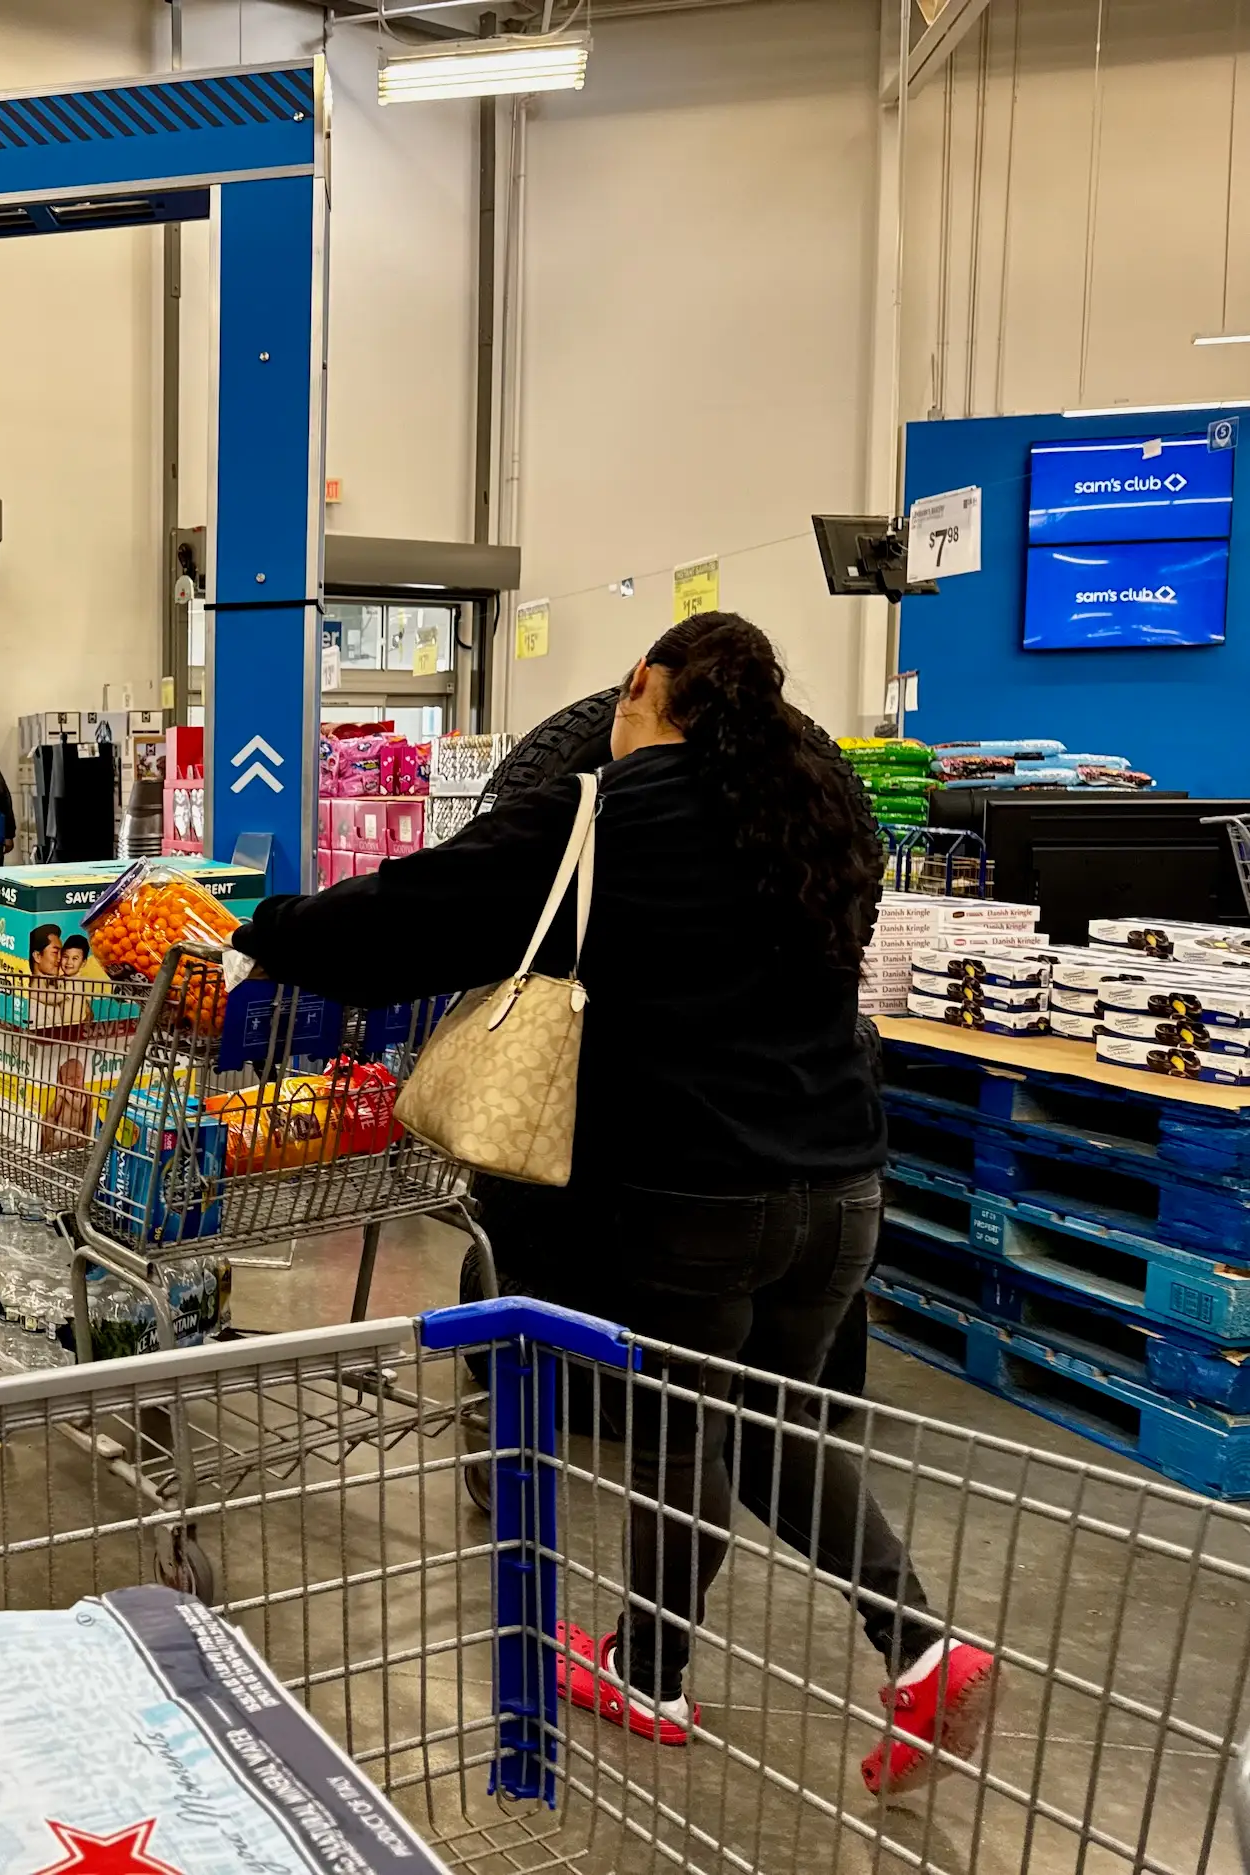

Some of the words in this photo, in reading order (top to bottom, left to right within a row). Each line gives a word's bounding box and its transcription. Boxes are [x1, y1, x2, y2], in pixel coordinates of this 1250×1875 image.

[1074, 477, 1121, 494] sam's
[1124, 475, 1162, 492] club
[1076, 589, 1117, 604] sam's
[1120, 587, 1154, 602] club
[1, 887, 18, 903] $45
[65, 891, 96, 905] SAVE
[881, 908, 905, 918] Danish
[906, 908, 931, 919] Kringle
[987, 909, 1009, 917] Danish
[1010, 909, 1033, 918] Kringle
[880, 924, 905, 933] Danish
[905, 924, 931, 934] Kringle
[880, 939, 905, 948] Danish
[906, 939, 931, 949] Kringle
[1016, 938, 1042, 946] Kringle
[882, 955, 905, 964] Danish
[882, 970, 905, 979] Danish
[882, 985, 905, 994] Danish
[879, 1001, 903, 1010] Danish
[82, 1021, 128, 1039] SAVE
[226, 1727, 268, 1768] WATER
